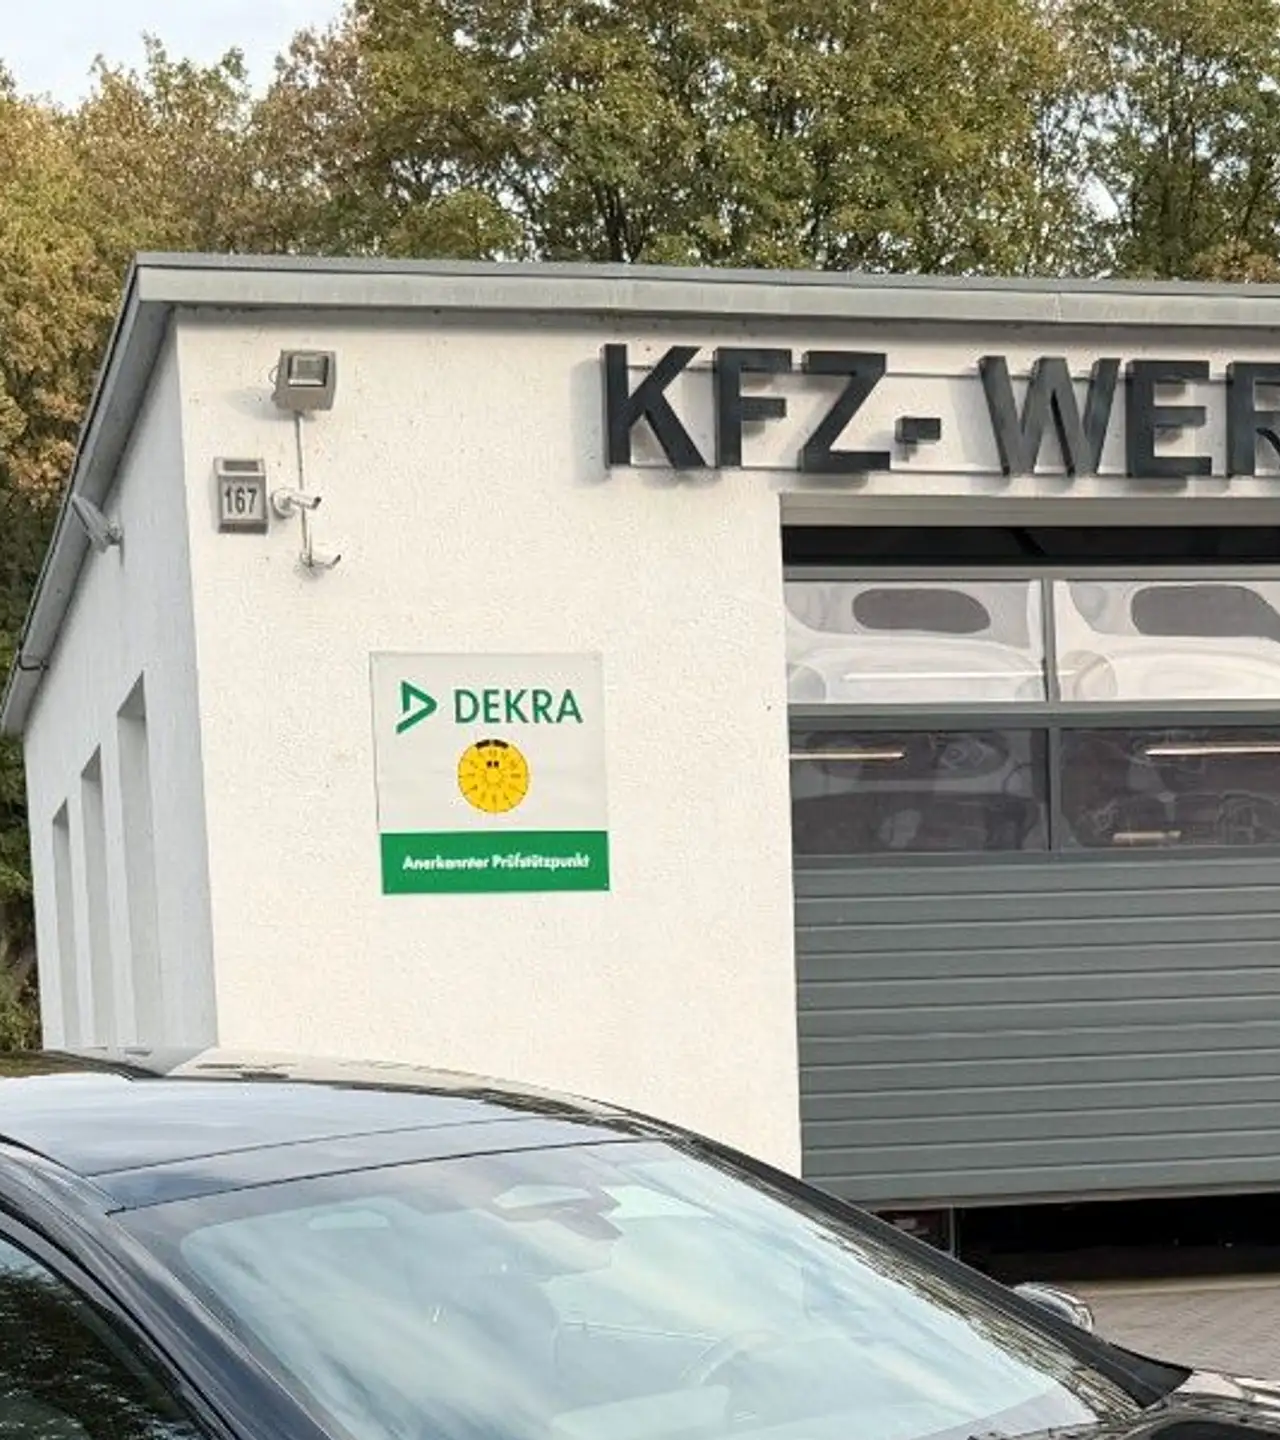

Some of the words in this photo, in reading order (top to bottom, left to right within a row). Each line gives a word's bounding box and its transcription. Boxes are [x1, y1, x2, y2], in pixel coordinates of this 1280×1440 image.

[225, 486, 257, 514] 167
[454, 688, 583, 725] DEKRA
[402, 855, 490, 871] Anerkannter
[491, 853, 590, 872] Prüfstützpunkt
